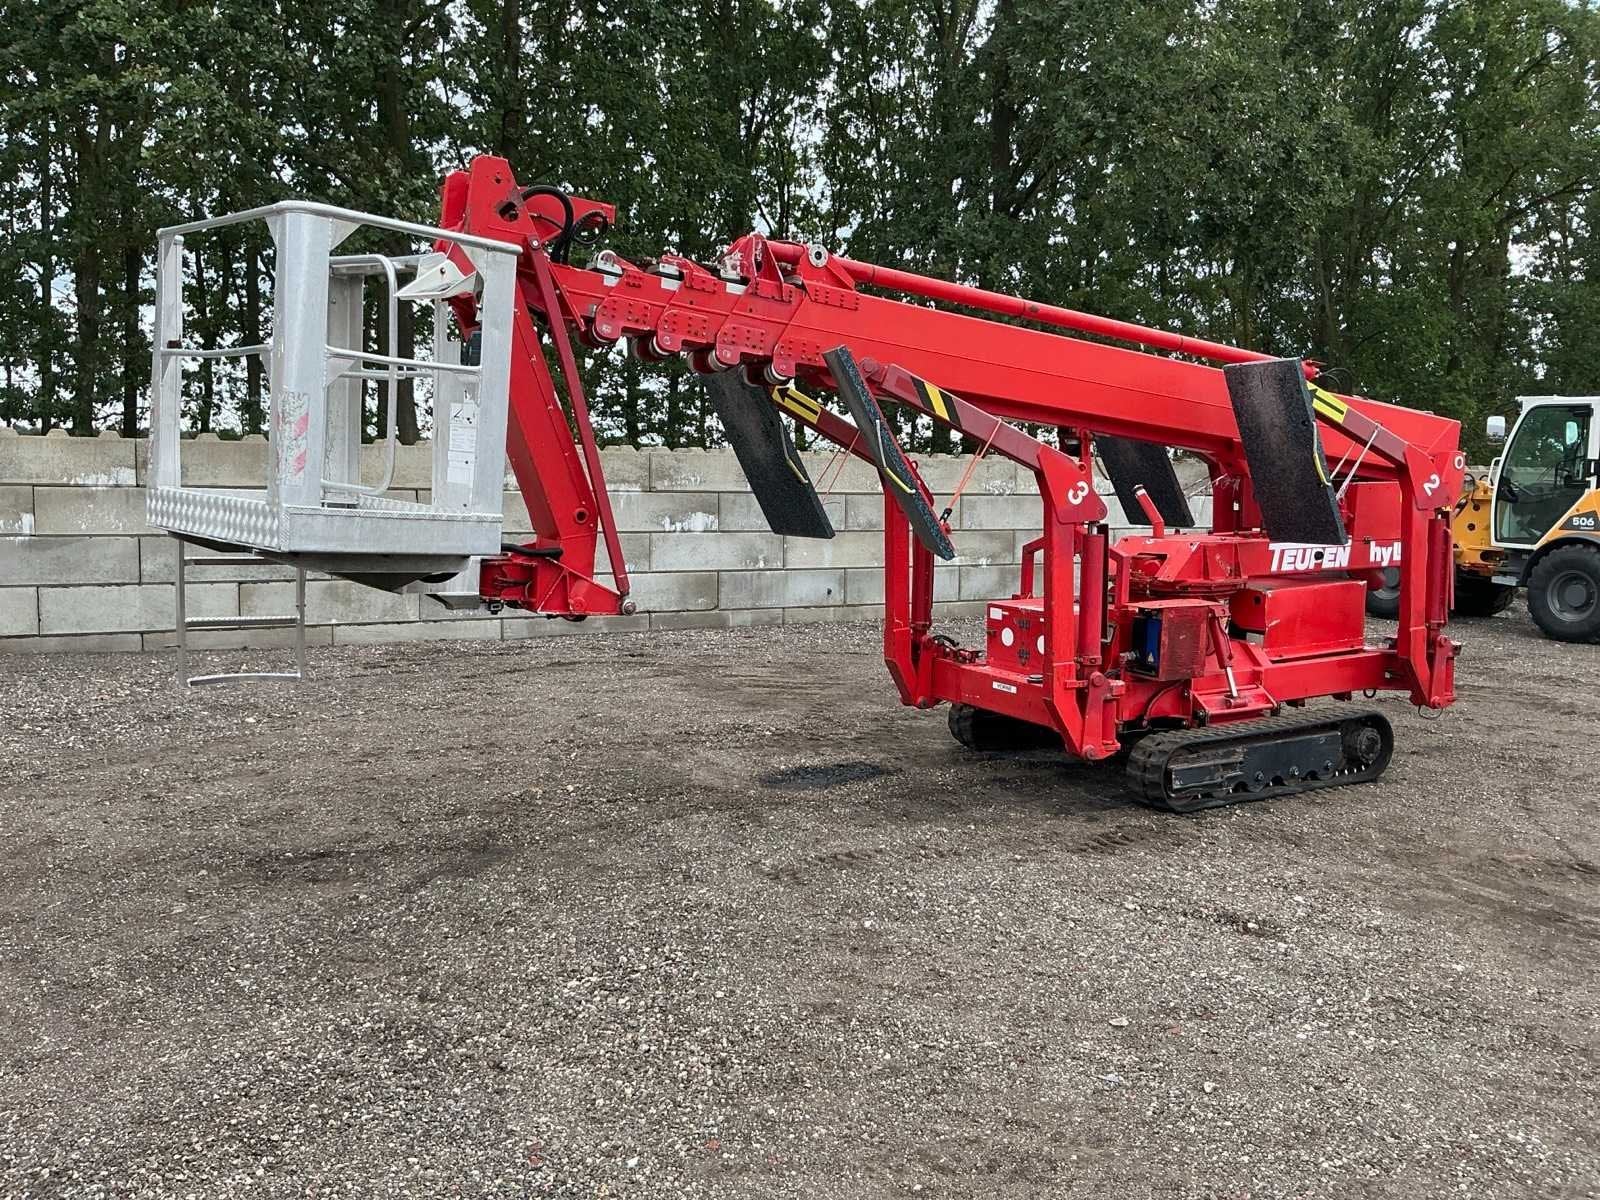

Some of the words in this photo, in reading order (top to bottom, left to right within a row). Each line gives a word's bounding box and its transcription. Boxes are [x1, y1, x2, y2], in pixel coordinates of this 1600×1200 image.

[1068, 480, 1090, 505] 3
[1423, 474, 1440, 497] 2
[1572, 517, 1595, 526] 506
[1268, 542, 1352, 572] TEUPEN
